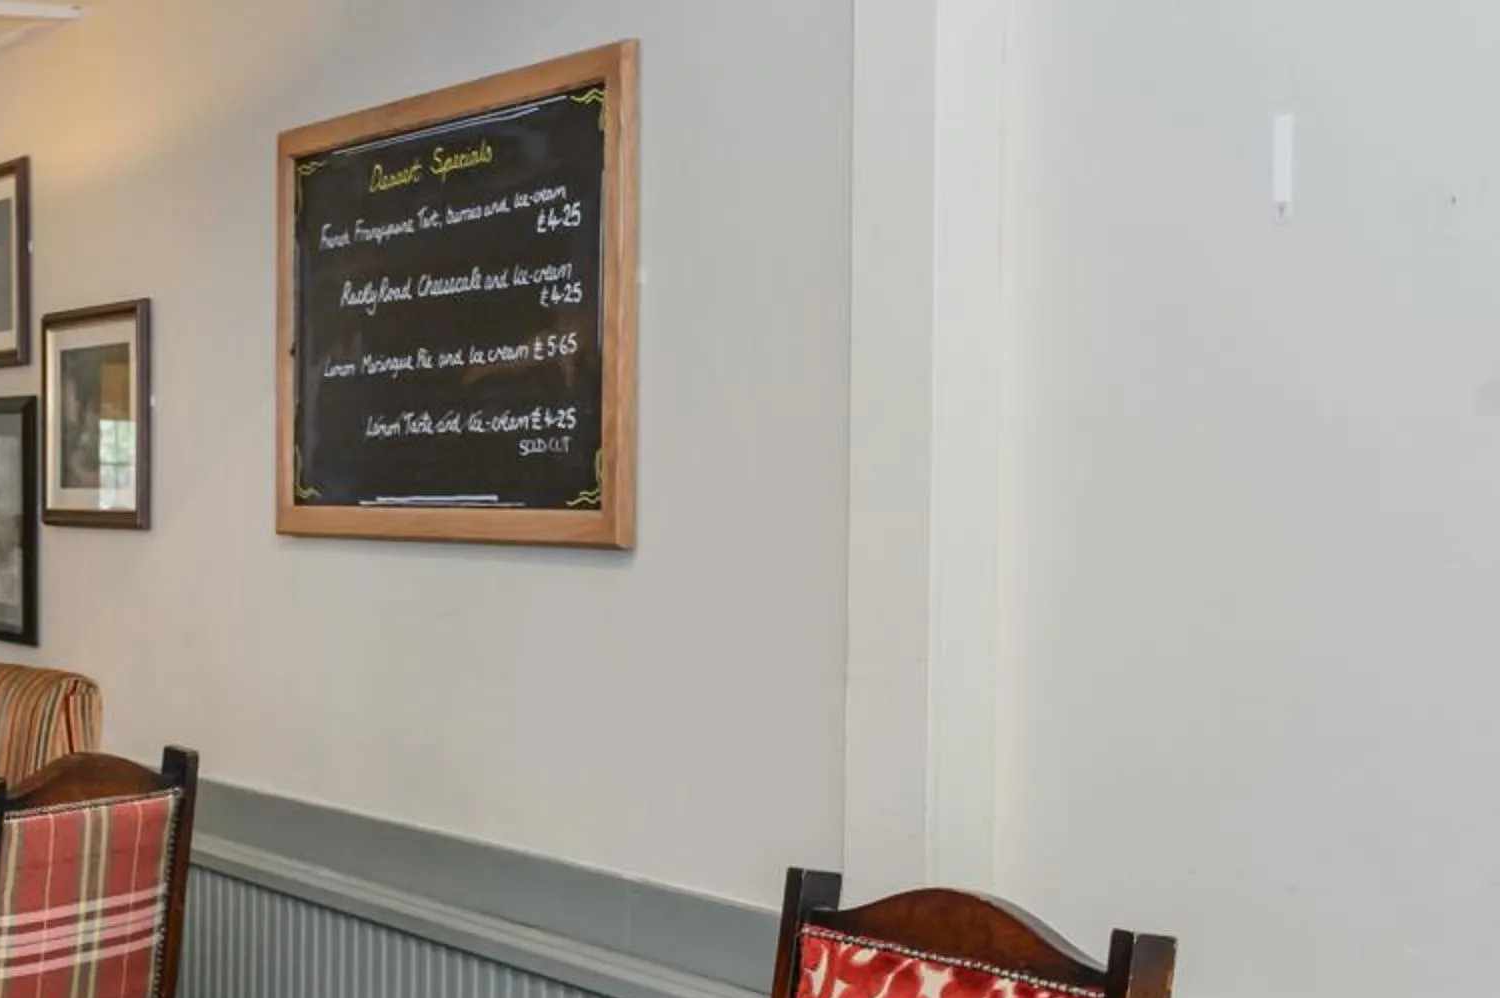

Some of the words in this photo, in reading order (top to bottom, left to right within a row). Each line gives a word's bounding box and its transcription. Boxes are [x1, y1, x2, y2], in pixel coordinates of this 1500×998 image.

[369, 160, 422, 192] Dessert
[429, 138, 493, 183] Specials
[483, 197, 511, 217] and
[417, 265, 482, 297] Cheesecake
[483, 269, 510, 290] and
[324, 355, 355, 377] Lemon
[416, 347, 433, 369] Pie
[438, 349, 465, 369] and
